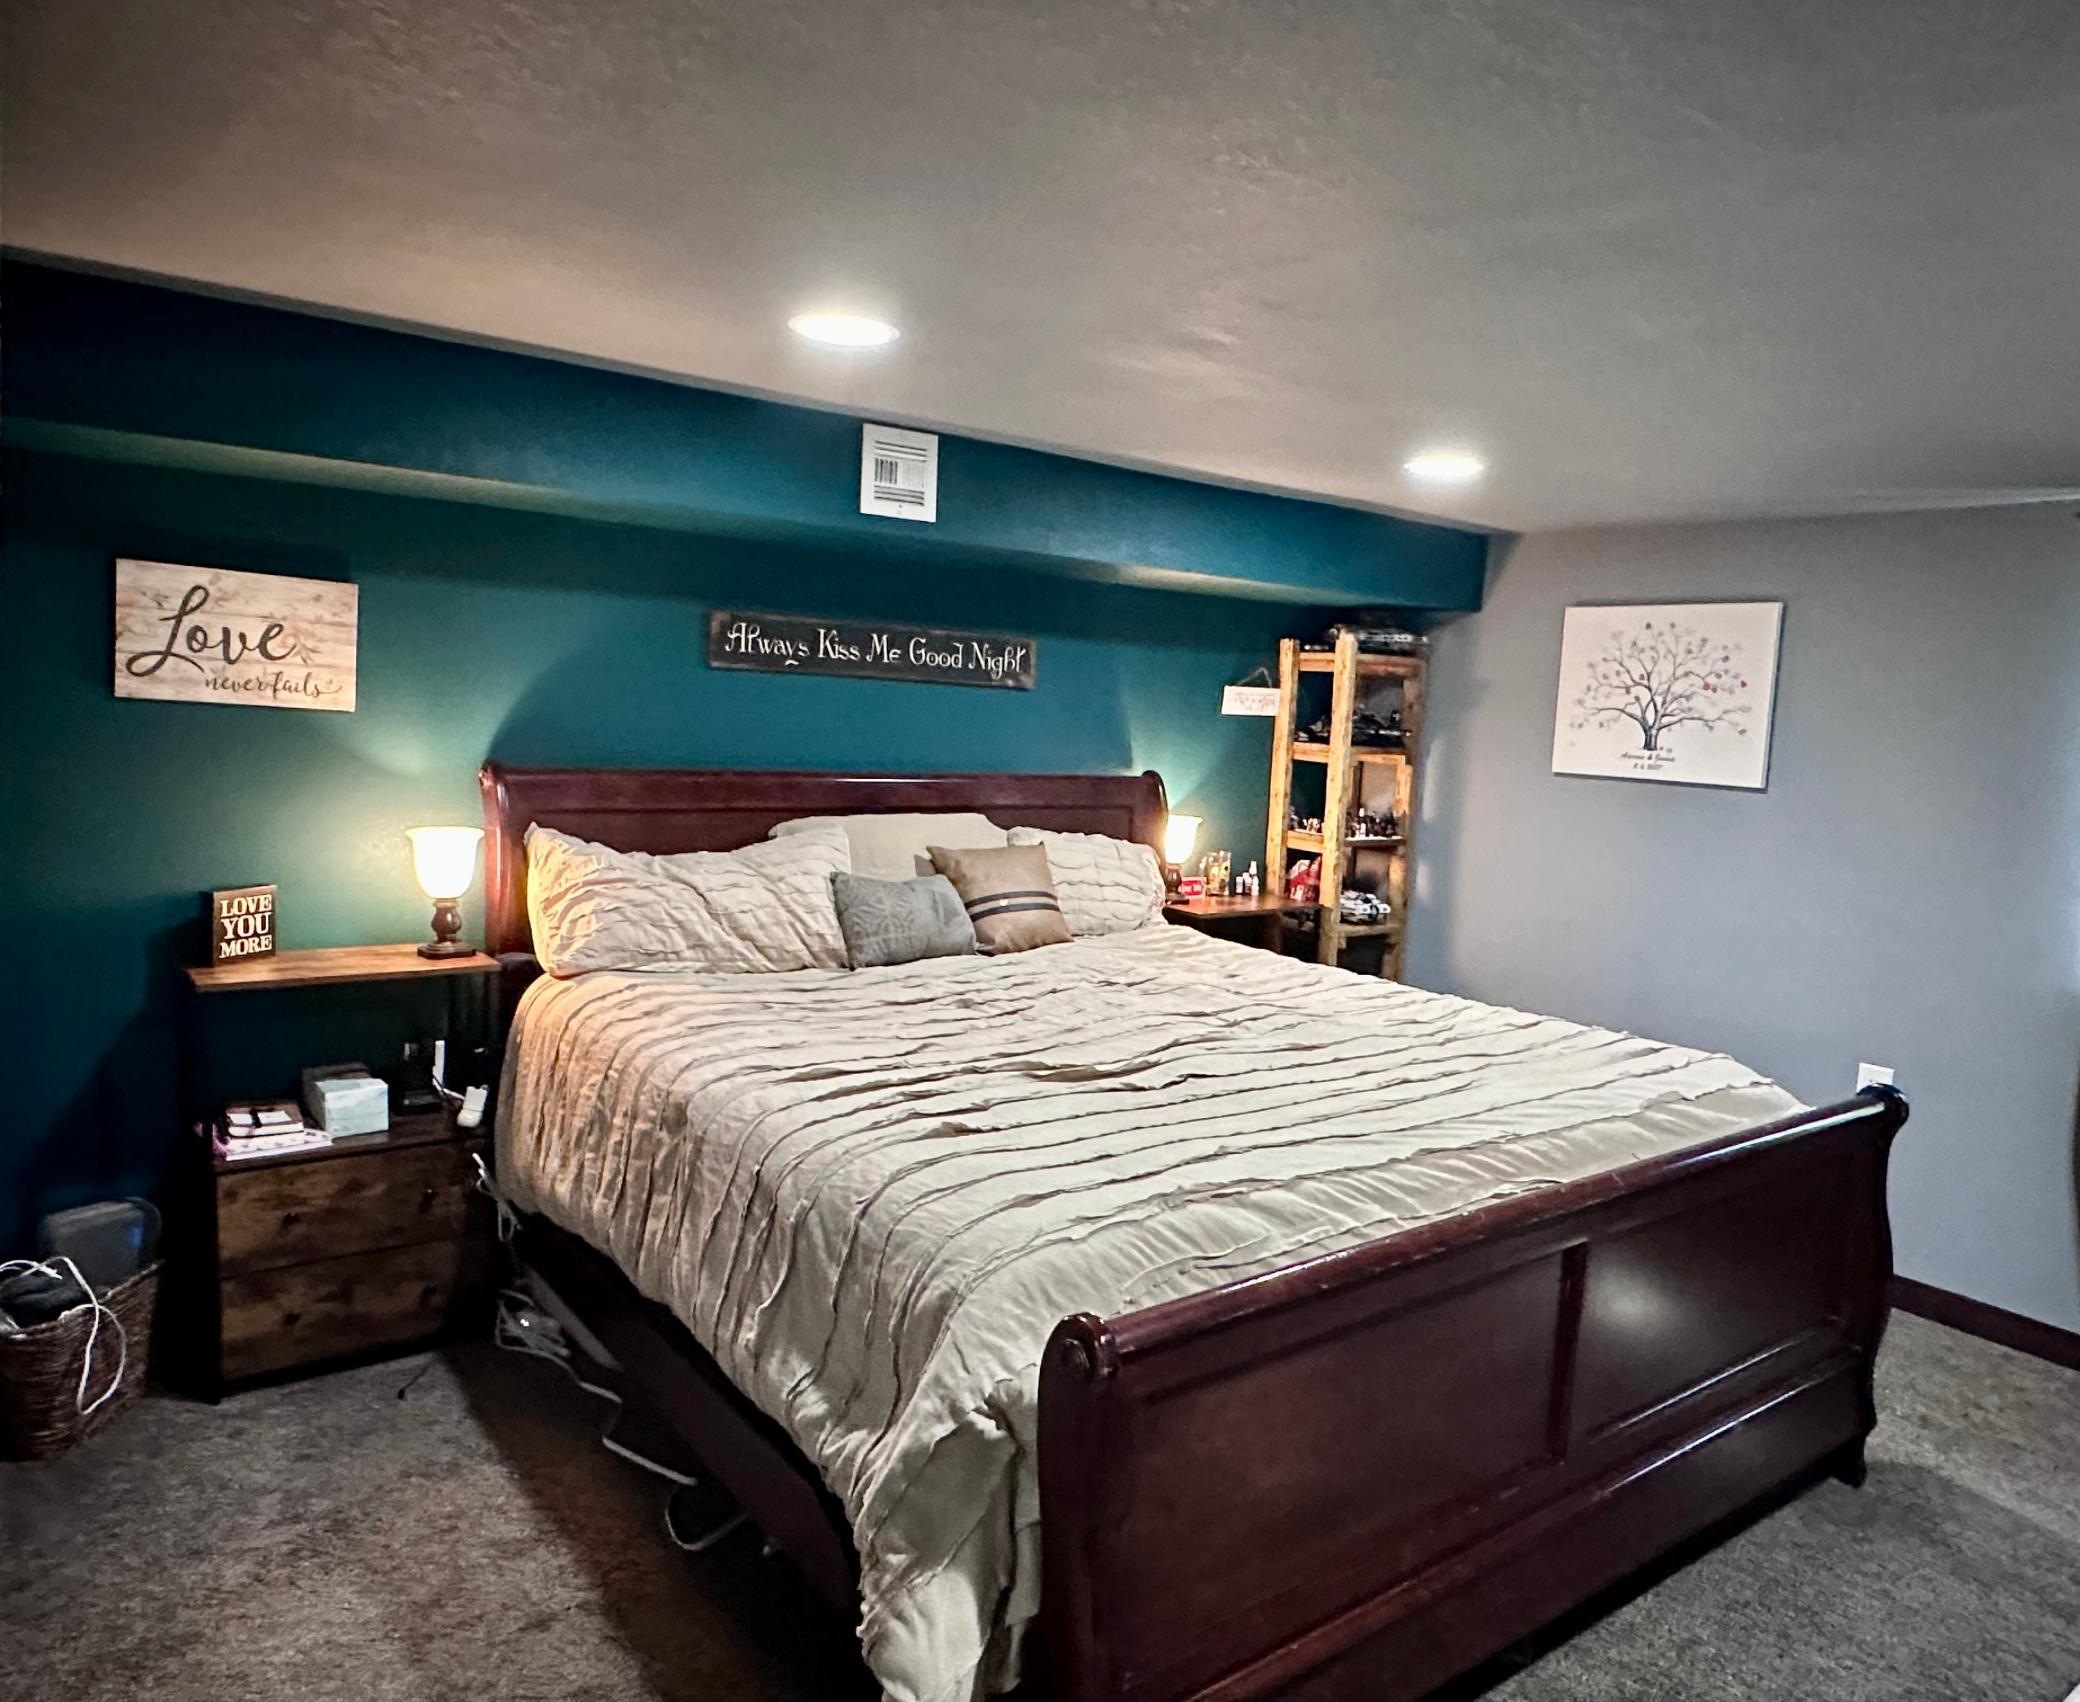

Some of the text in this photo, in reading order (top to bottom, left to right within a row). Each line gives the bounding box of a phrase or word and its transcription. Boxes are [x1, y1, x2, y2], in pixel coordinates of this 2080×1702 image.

[125, 584, 297, 677] Love
[724, 622, 1027, 680] Always Kiss Me Good Night
[205, 671, 342, 700] never fails
[220, 894, 272, 917] LOVE
[220, 912, 272, 940] YOU
[219, 935, 272, 958] MORE
